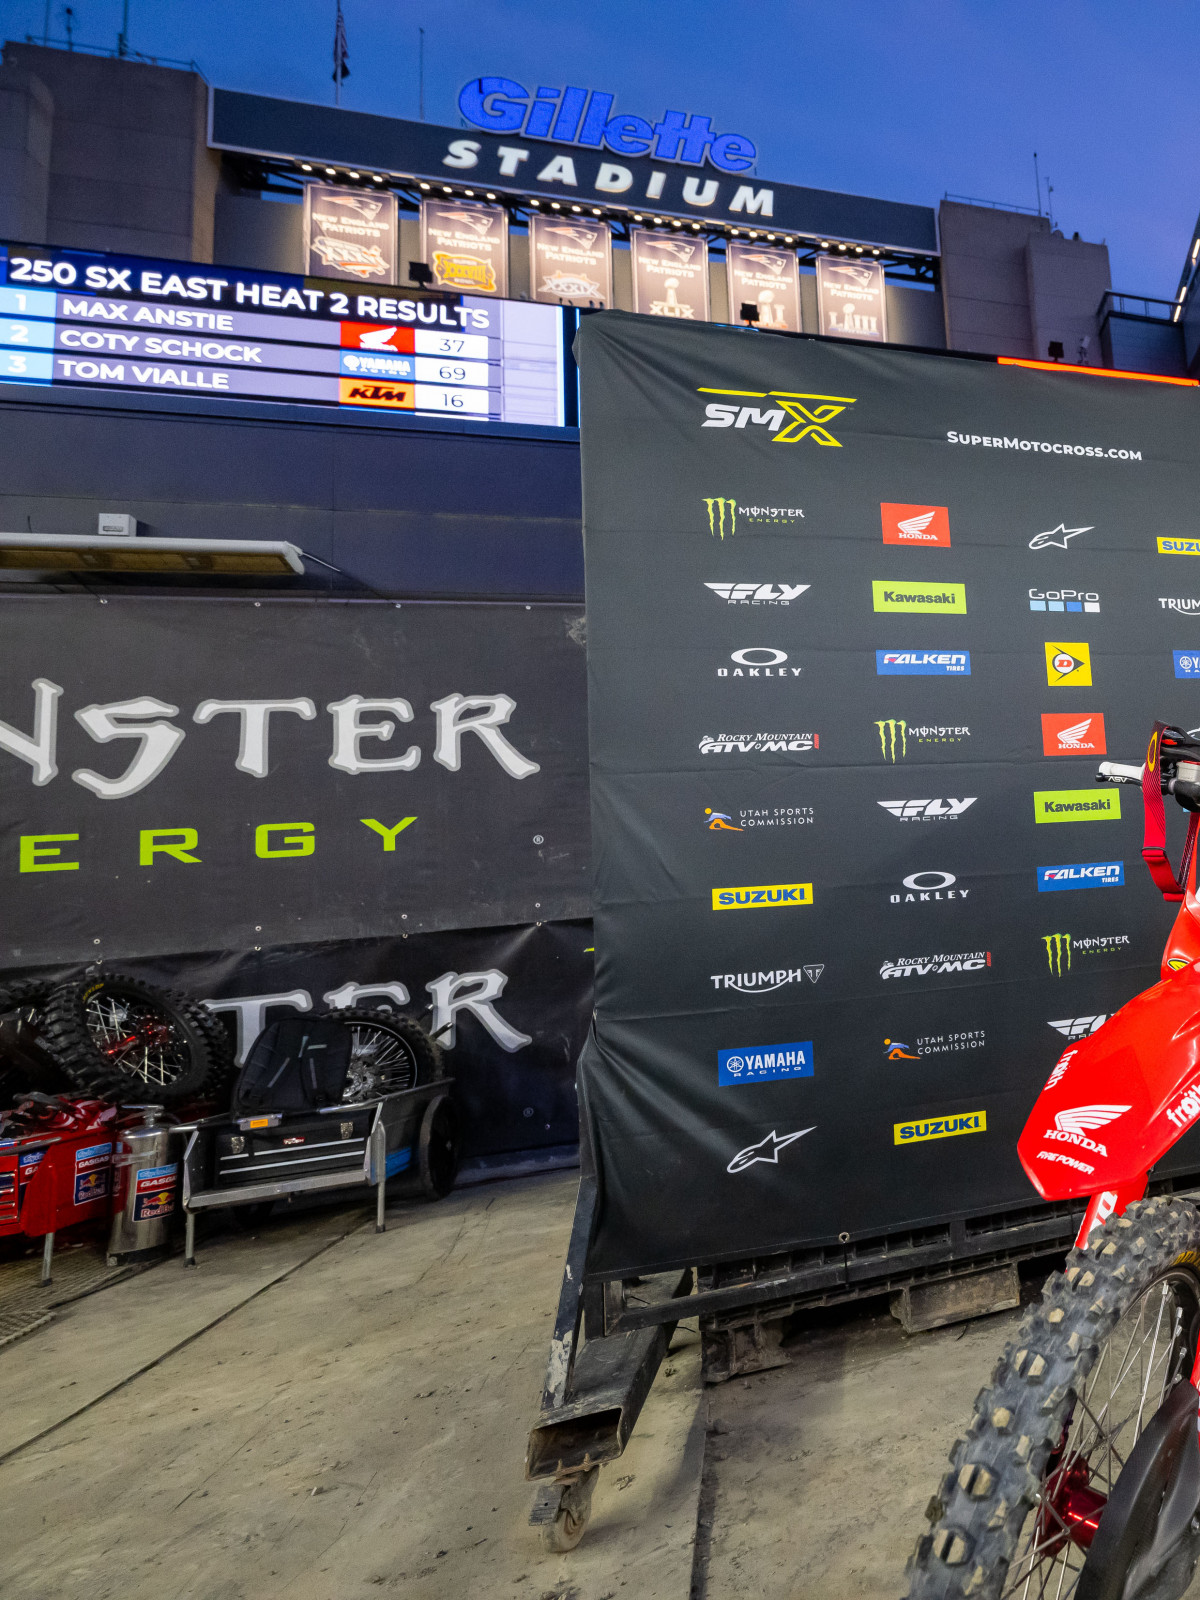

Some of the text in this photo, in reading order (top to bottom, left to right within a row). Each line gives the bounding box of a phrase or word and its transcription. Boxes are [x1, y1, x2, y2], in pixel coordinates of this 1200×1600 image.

[459, 76, 757, 172] Gillette
[442, 140, 774, 217] STADIUM
[312, 212, 389, 231] NEW ENGLAND
[322, 222, 381, 238] PATRIOTS
[428, 227, 501, 244] NEW ENGLAND
[437, 237, 492, 251] PATRIOTS
[536, 242, 605, 259] NEW ENGLAND
[545, 251, 597, 266] PATRIOTS
[638, 256, 702, 272] NEW ENGLAND
[646, 265, 695, 279] PATRIOTS
[741, 278, 787, 290] PATRIOTS
[10, 258, 490, 329] 250 SX EAST HEAT 2 RESULTS
[830, 289, 874, 301] PATRIOTS
[15, 294, 465, 353] 1 MAX ANSTIE 37
[10, 325, 466, 381] 2 COTY SCHOCK 69
[8, 355, 464, 408] 3 TOM VIALLE KTM 16
[701, 400, 847, 448] SMX
[738, 505, 805, 519] MONSTER
[898, 532, 938, 541] HONDA
[884, 591, 956, 604] Kawasaki
[1029, 588, 1099, 601] GoPro
[884, 653, 966, 665] FALKEN
[717, 668, 802, 677] OAKLEY
[718, 733, 752, 743] ROCKY
[755, 732, 813, 742] MOUNTAIN
[908, 726, 971, 738] MONSTER
[1058, 742, 1095, 750] HONDA
[740, 807, 815, 817] UTAH SPORTS
[1044, 799, 1111, 813] Kawasaki
[740, 817, 814, 827] COMMISSION
[1044, 865, 1120, 881] FALKEN
[1101, 875, 1119, 883] TIRES
[719, 887, 806, 906] SUZUKI
[890, 889, 970, 904] OAKLEY
[1073, 935, 1131, 950] MONSTER
[1082, 946, 1122, 955] ENERGY
[897, 951, 986, 966] ROCKY MOUNTAIN
[710, 967, 802, 994] TRIUMPH
[917, 1030, 986, 1045] UTAH SPORTS
[917, 1040, 986, 1055] COMMISSION
[745, 1049, 806, 1070] YAMAHA
[733, 1065, 802, 1077] RACING
[900, 1115, 981, 1140] SUZUKI
[1044, 1129, 1108, 1158] HONDA
[78, 1155, 110, 1169] GASGAS
